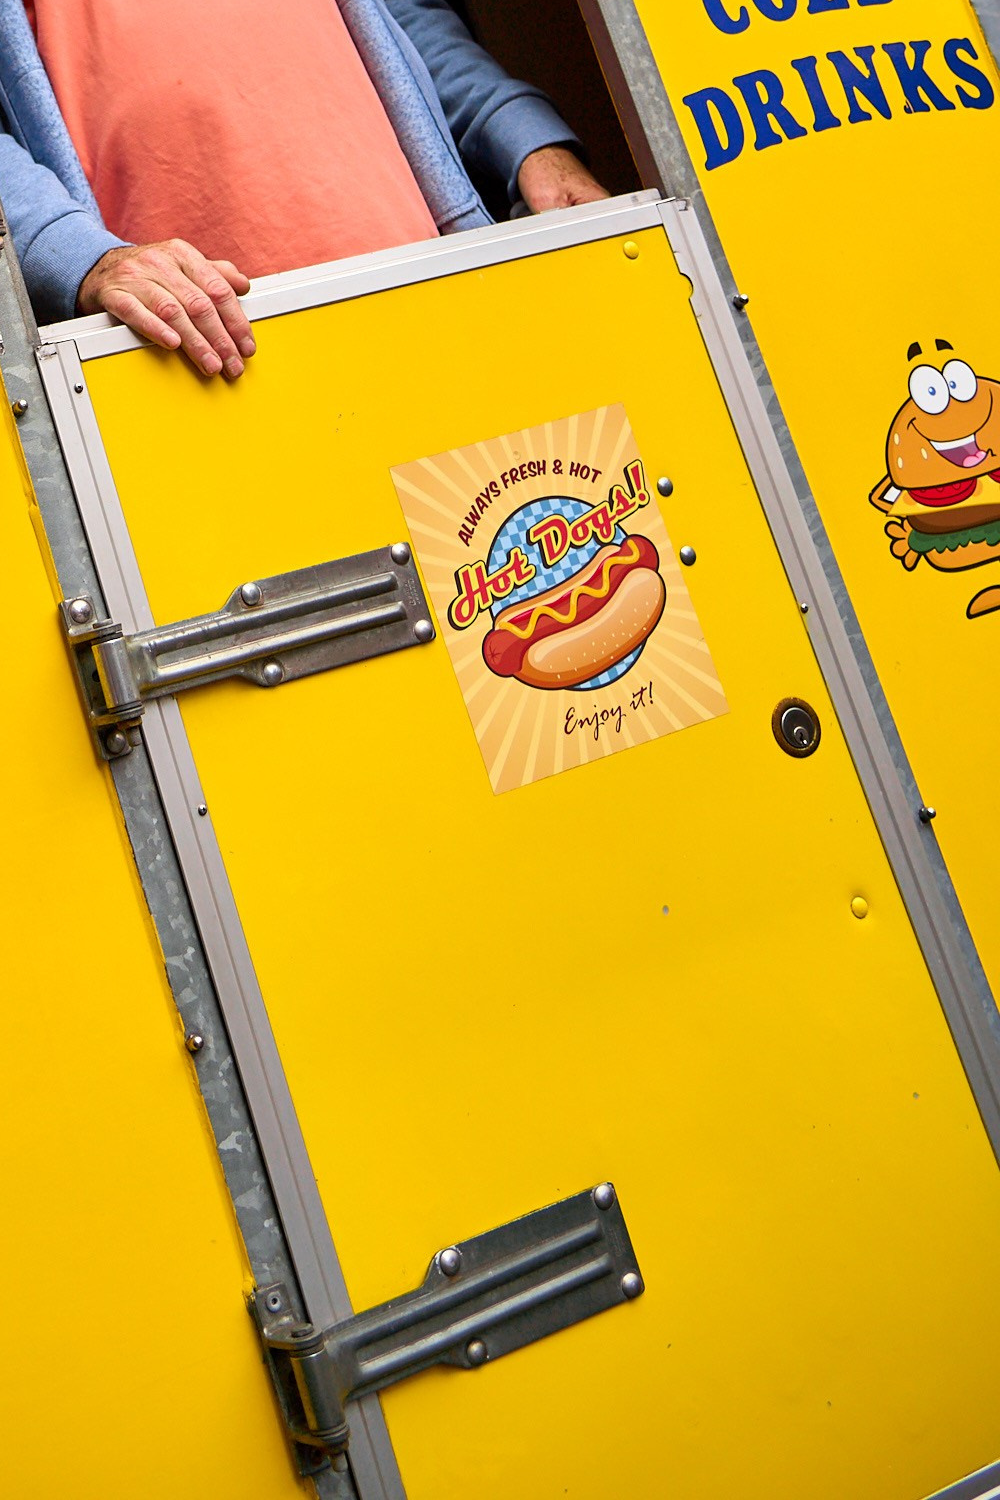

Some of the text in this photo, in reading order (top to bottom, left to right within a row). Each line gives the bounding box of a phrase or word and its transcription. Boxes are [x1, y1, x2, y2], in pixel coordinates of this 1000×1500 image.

[682, 38, 994, 171] DRINKS
[448, 459, 650, 631] Hot Dogs!
[458, 459, 602, 547] ALWAYS FRESH & HOT
[564, 680, 654, 741] Enjoy it!
